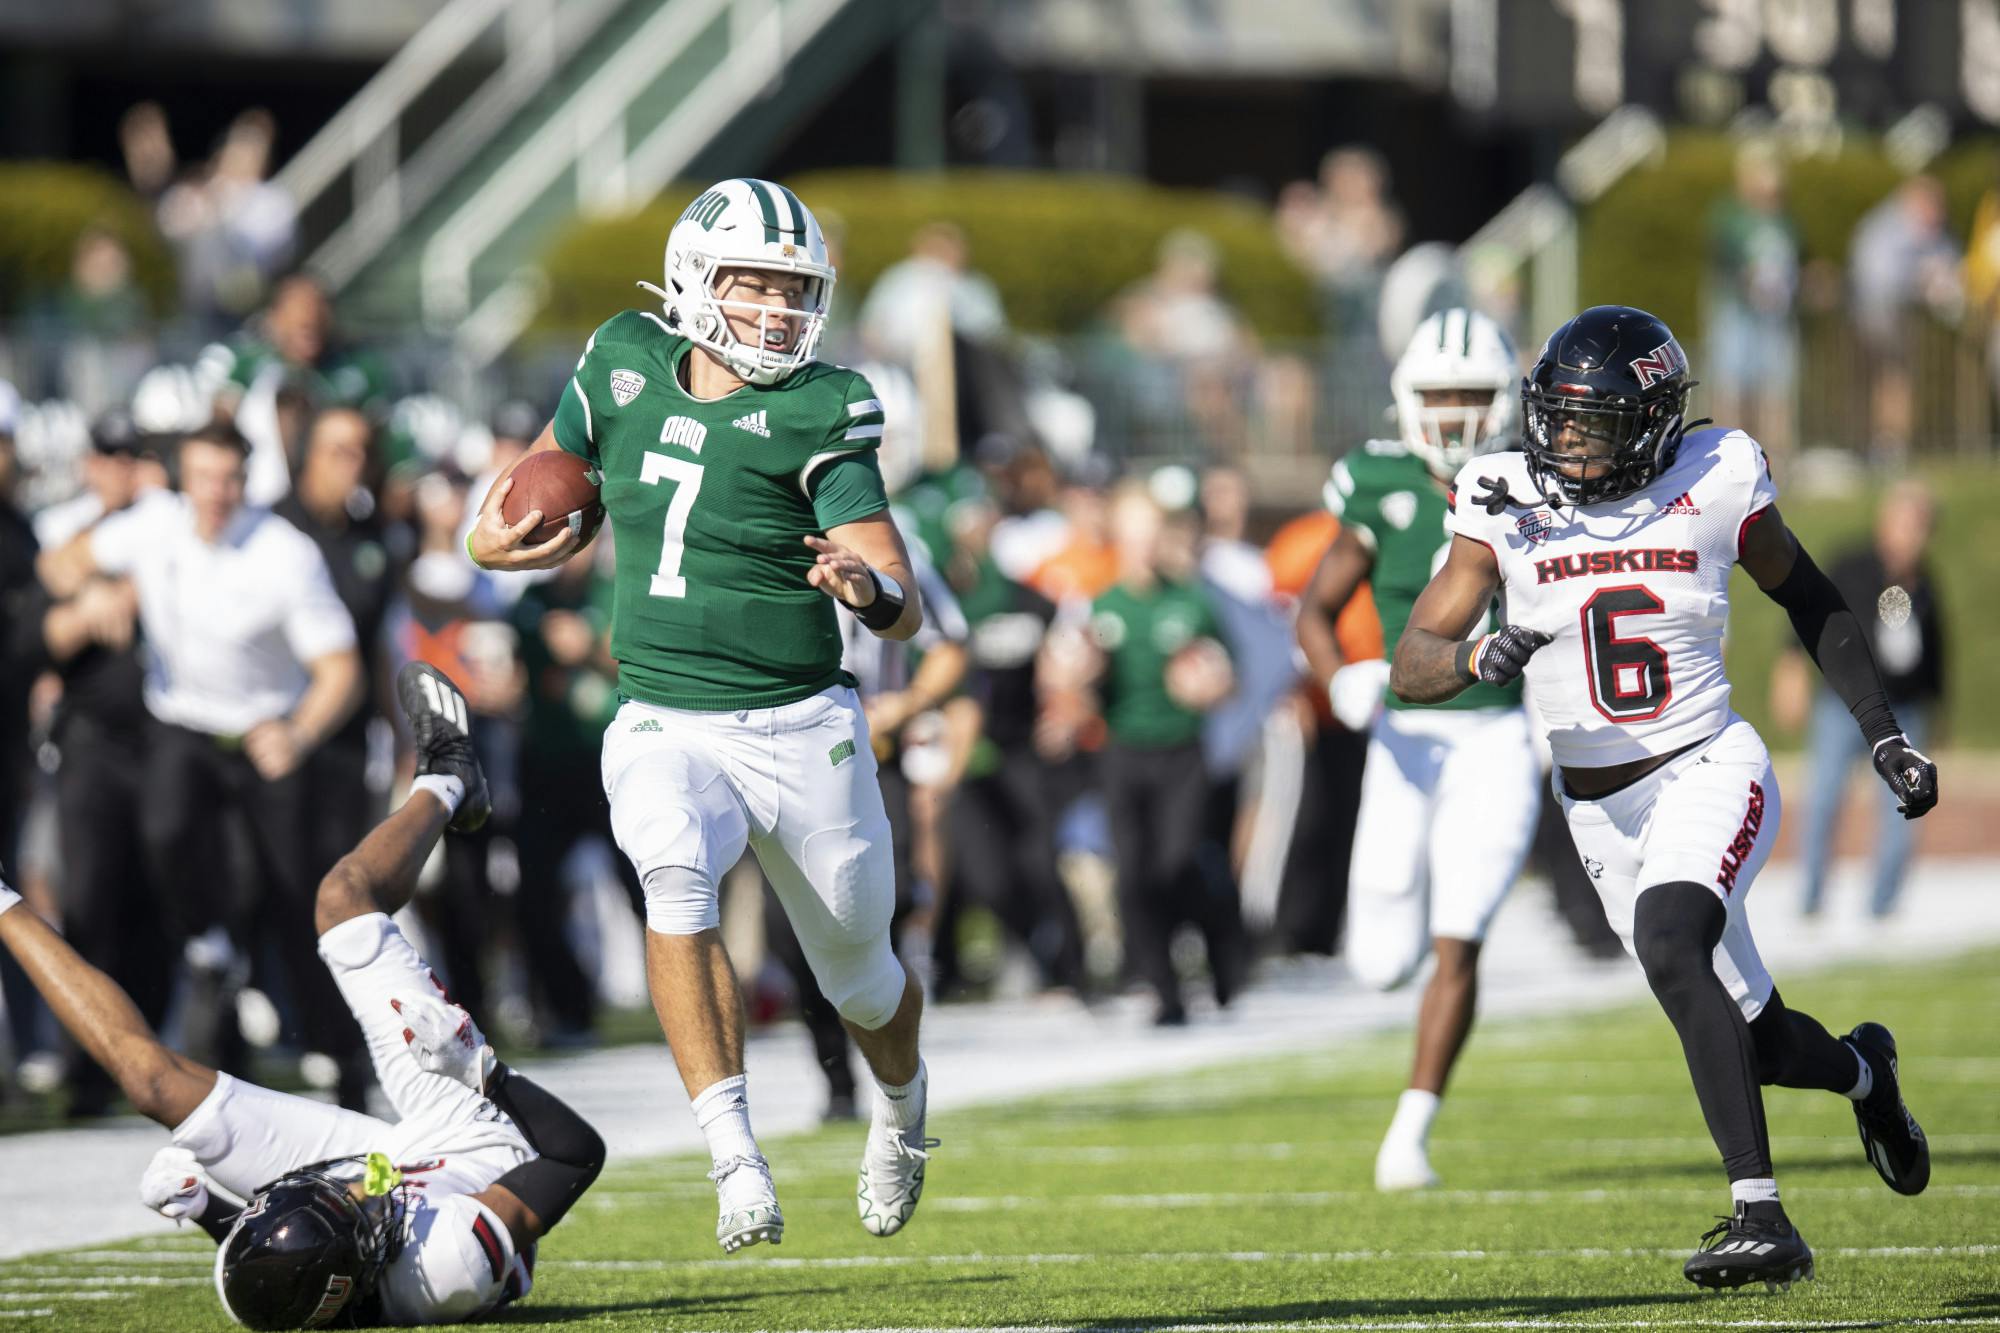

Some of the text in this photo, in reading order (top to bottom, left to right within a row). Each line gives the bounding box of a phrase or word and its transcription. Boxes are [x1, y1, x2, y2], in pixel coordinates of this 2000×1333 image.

[612, 378, 641, 393] MAC
[659, 416, 708, 456] OHIO
[732, 419, 771, 438] adidas
[639, 451, 704, 598] 7
[1519, 518, 1552, 537] MAC
[1660, 506, 1701, 515] adidas
[1534, 548, 1699, 585] HUSKIES
[1580, 583, 1672, 723] 6
[1716, 779, 1765, 897] HUSKIES
